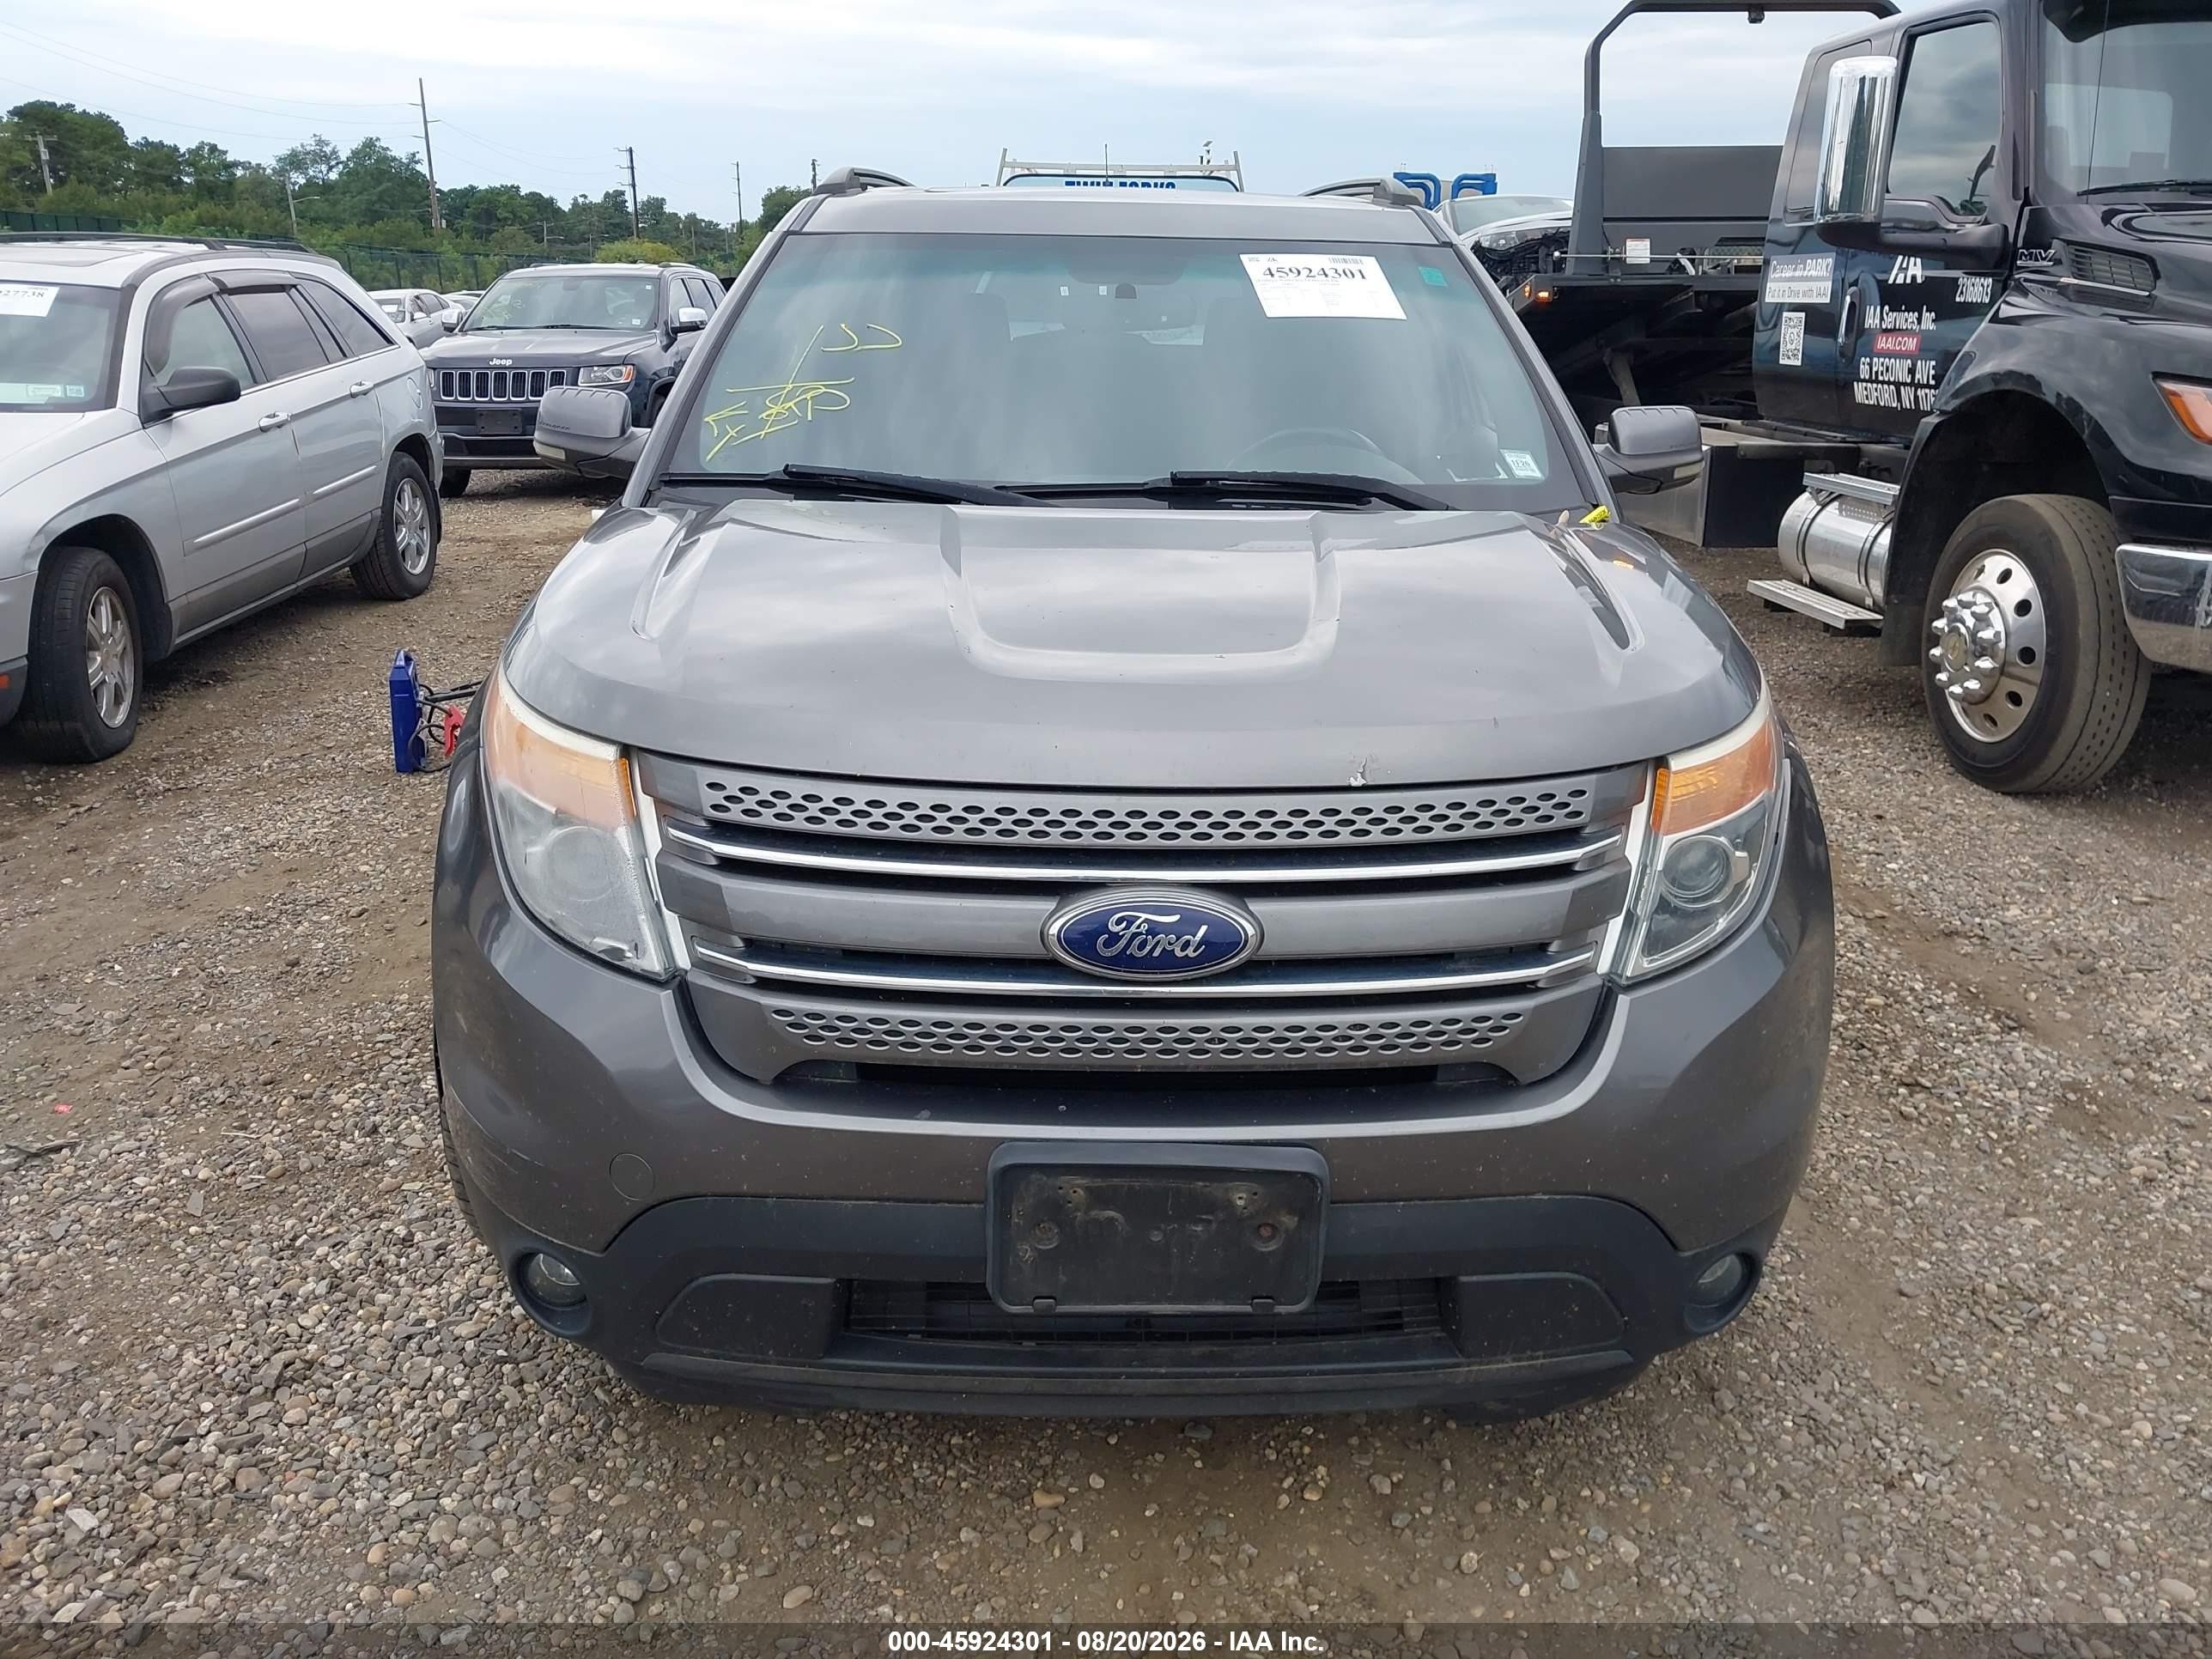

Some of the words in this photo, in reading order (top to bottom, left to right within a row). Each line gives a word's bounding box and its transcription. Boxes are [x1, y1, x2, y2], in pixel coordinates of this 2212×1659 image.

[2016, 249, 2057, 263] MV
[1263, 266, 1367, 280] 45924301
[1771, 260, 1795, 278] Career
[1796, 259, 1803, 276] in
[1804, 258, 1832, 277] PARK?
[1787, 286, 1800, 299] Drive
[1802, 287, 1814, 298] with
[1815, 286, 1828, 299] IAAI
[1955, 276, 1992, 303] 23168613
[1864, 305, 1881, 329] IAA
[1881, 304, 1920, 332] Services,
[1921, 304, 1936, 330] Inc.
[1877, 336, 1917, 350] IAAI.COM
[489, 357, 513, 367] Jeep
[1860, 356, 1870, 380] 66
[1872, 356, 1911, 384] PECONIC
[1915, 360, 1936, 385] AVE
[1853, 381, 1900, 411] MEDFORD,
[1900, 386, 1916, 410] NY
[1917, 387, 1939, 411] 1176
[1097, 911, 1209, 957] Ford
